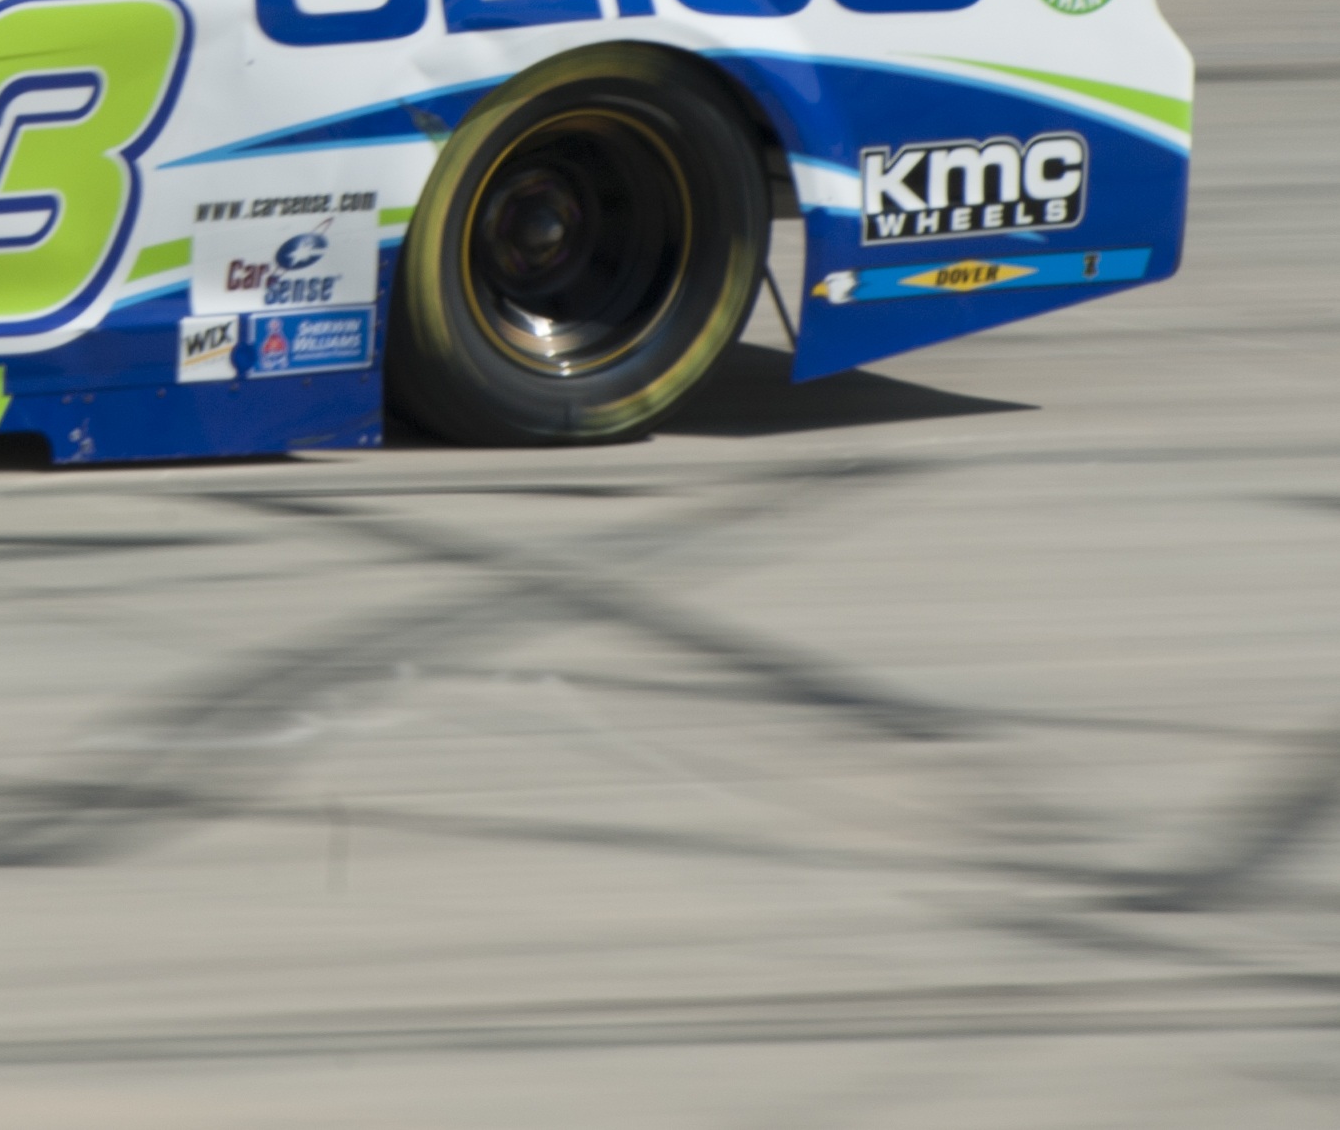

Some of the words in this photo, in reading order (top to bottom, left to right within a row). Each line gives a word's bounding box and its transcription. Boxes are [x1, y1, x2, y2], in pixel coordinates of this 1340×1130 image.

[194, 190, 377, 222] www.carsense.com
[876, 198, 1068, 238] WHEELS
[225, 258, 270, 292] Car
[934, 265, 1000, 286] DOVER
[183, 320, 234, 357] WIX
